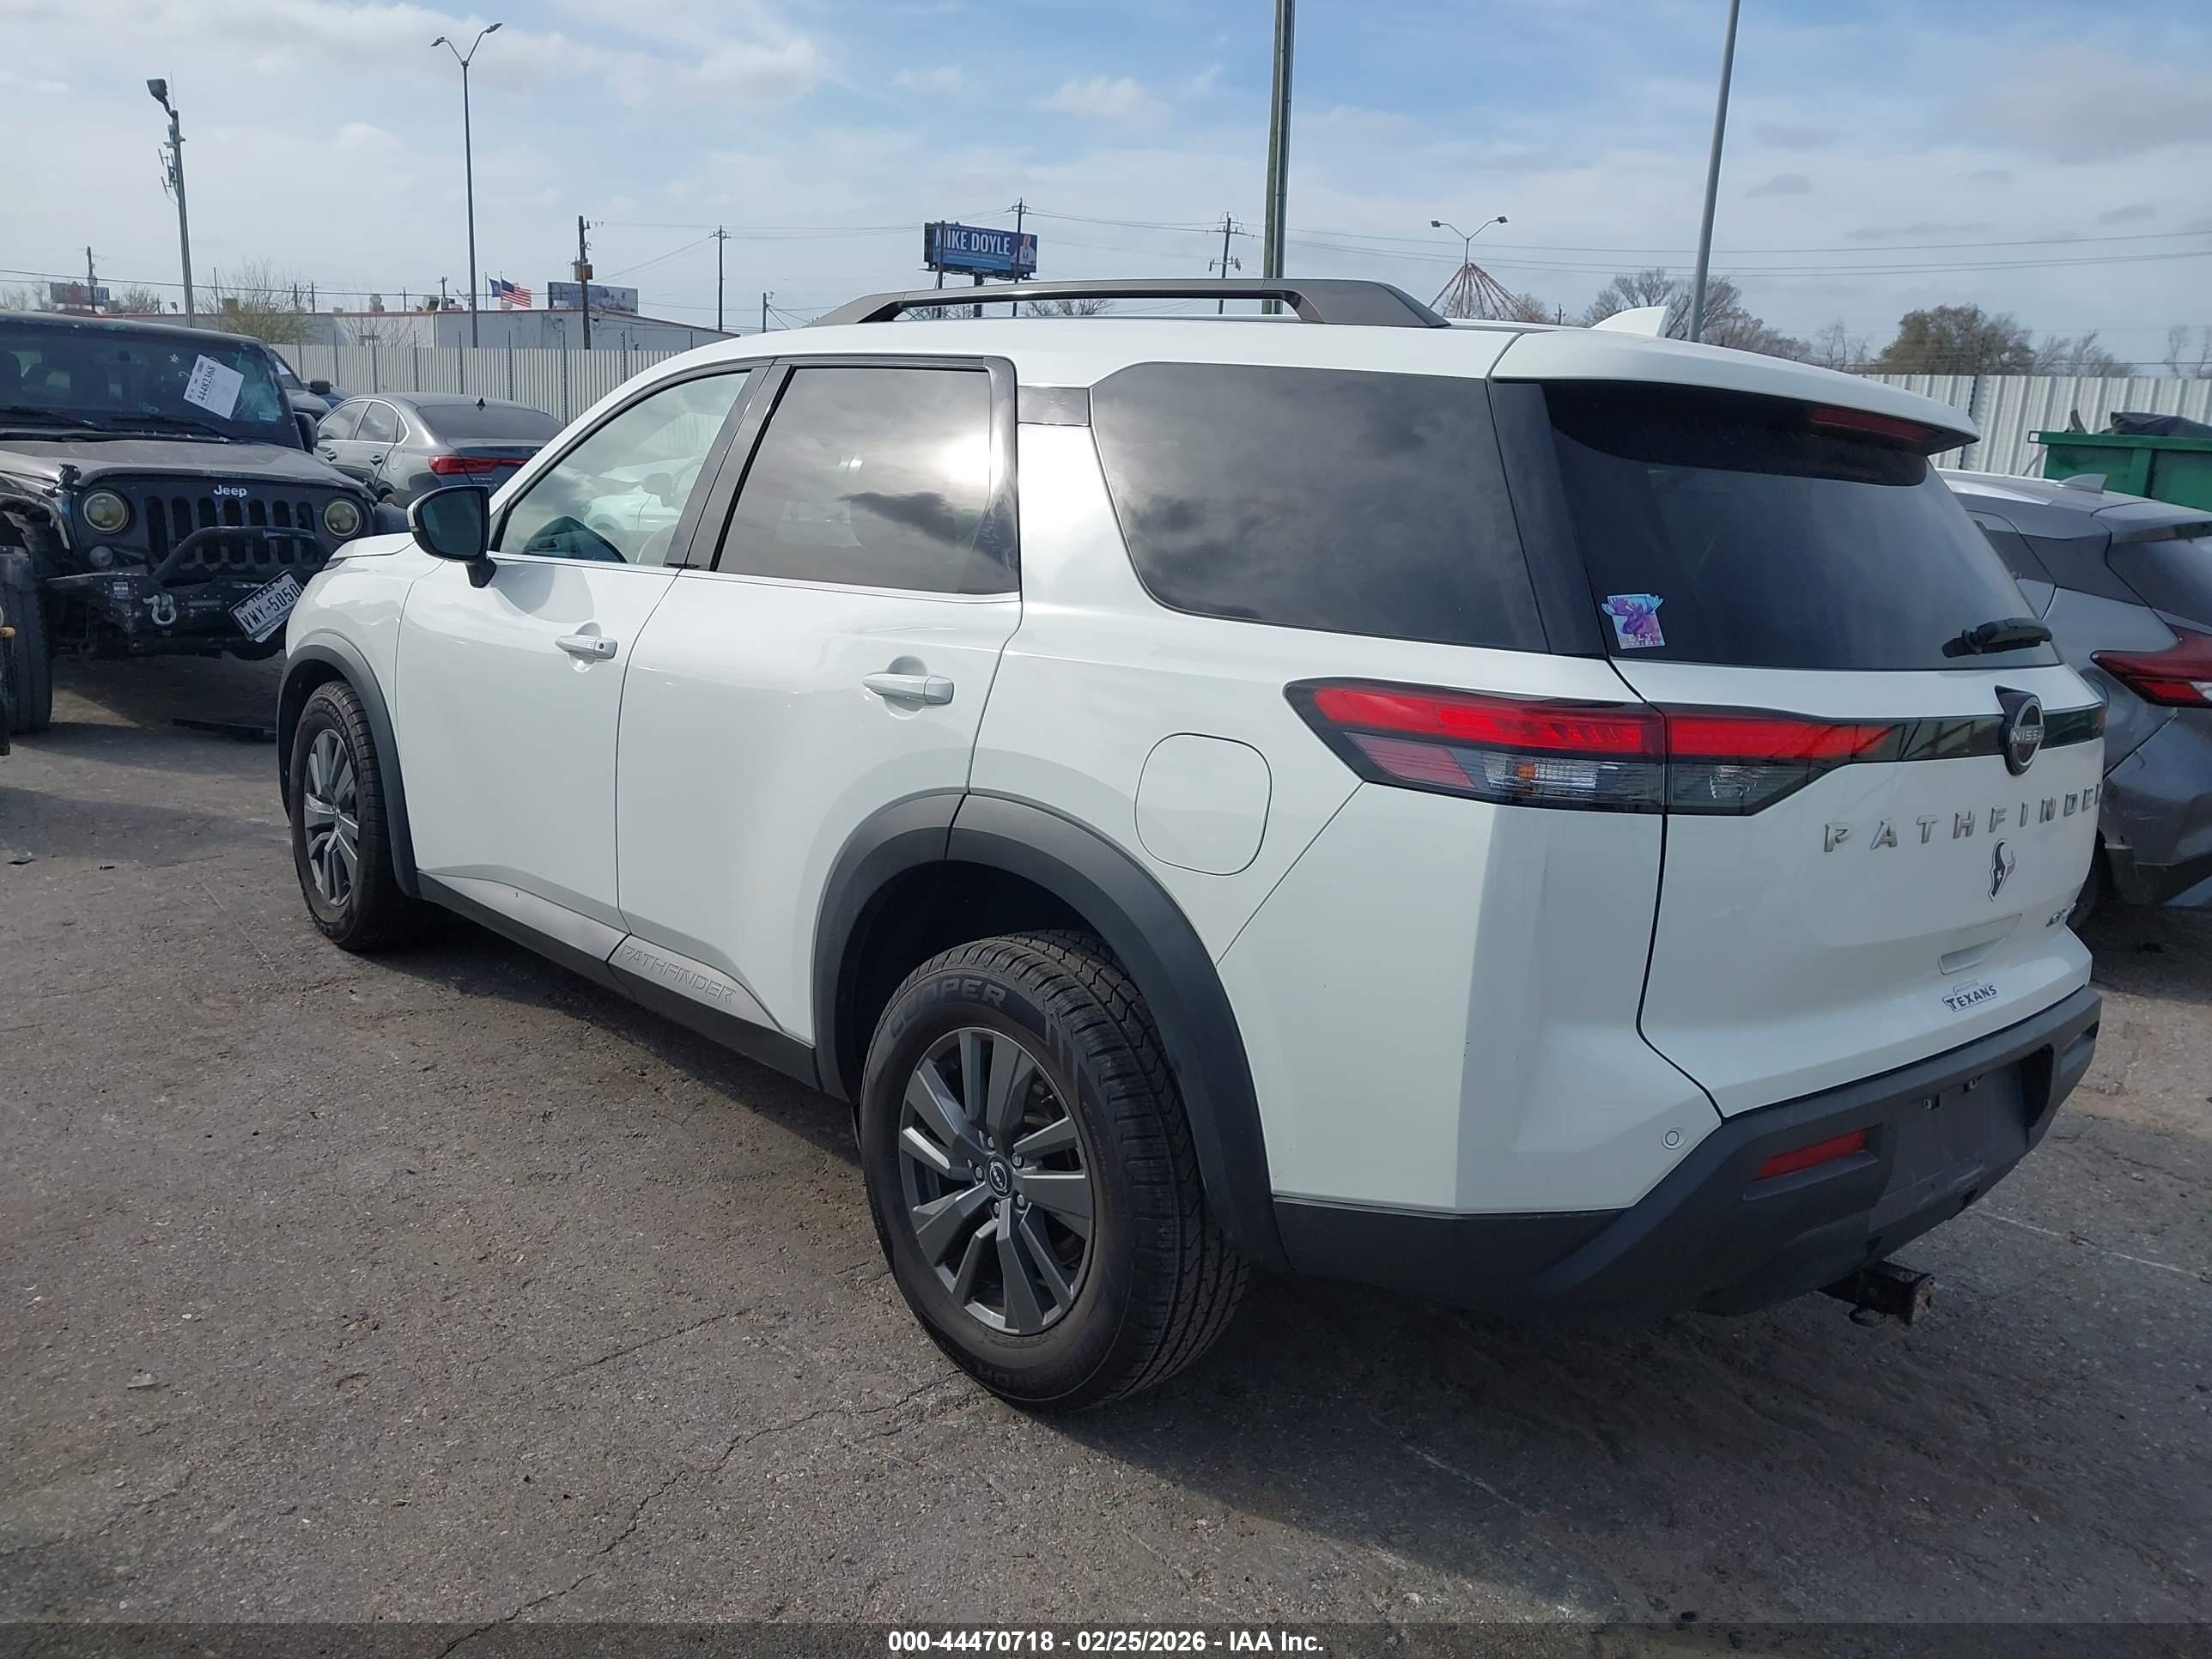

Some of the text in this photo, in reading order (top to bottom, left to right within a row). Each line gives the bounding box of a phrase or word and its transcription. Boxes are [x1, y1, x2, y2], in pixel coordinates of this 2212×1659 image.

[971, 233, 1011, 255] DOYLE
[213, 484, 247, 498] Jeep
[252, 584, 276, 603] TEXAS
[267, 583, 301, 612] 5050
[2010, 729, 2042, 742] NISS
[617, 945, 737, 1004] PATHFINDER
[1945, 984, 1997, 1010] TEXANS
